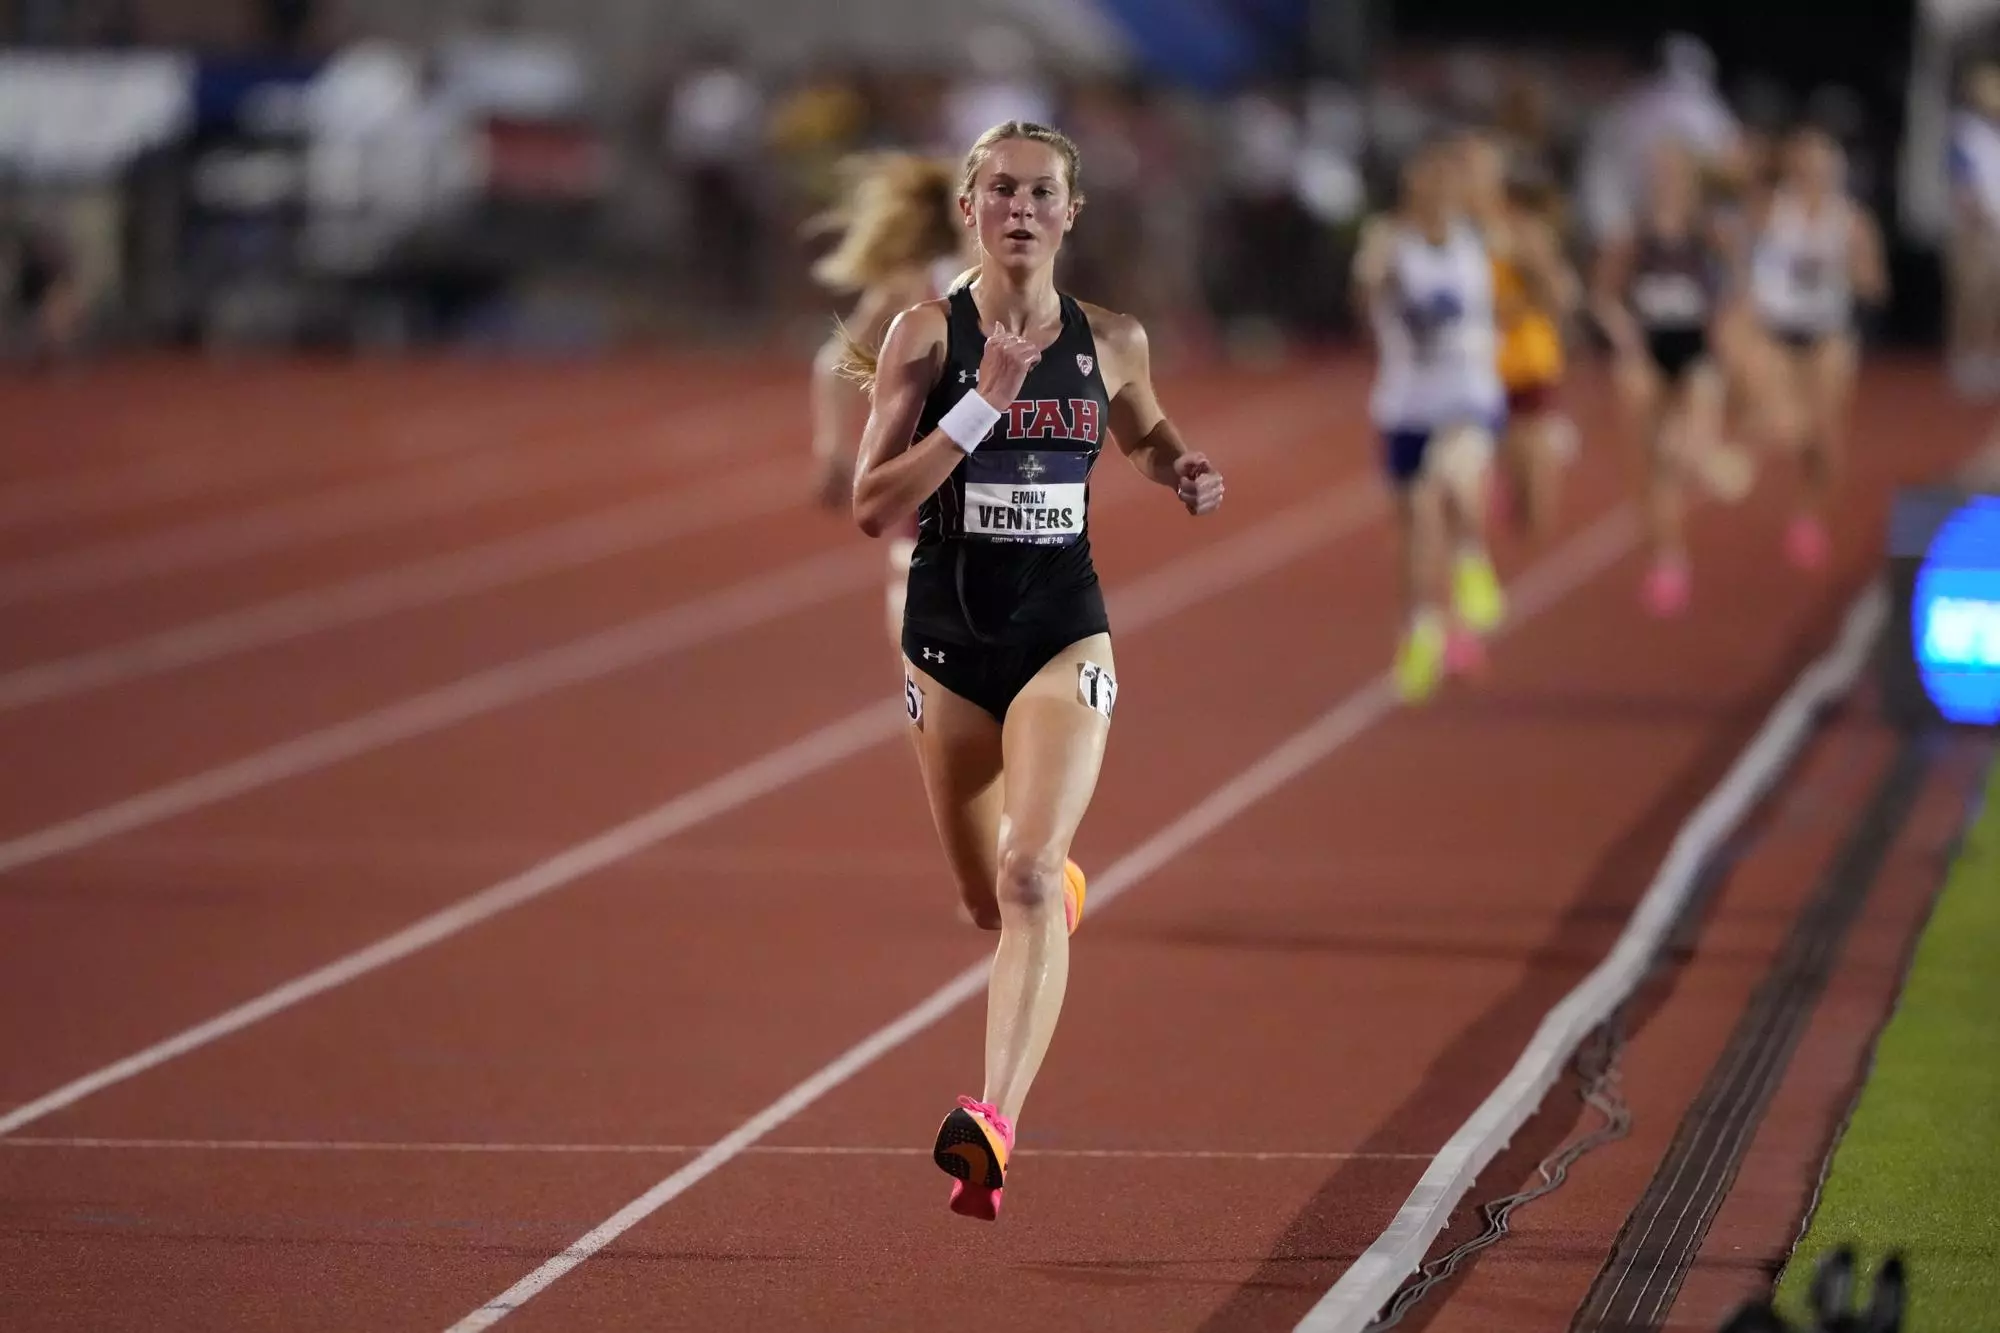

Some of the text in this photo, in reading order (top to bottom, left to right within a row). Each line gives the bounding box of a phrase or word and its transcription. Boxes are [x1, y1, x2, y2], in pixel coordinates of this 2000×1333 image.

[981, 399, 1099, 444] TAH
[1011, 490, 1046, 505] EMILY
[978, 505, 1074, 531] VENTERS
